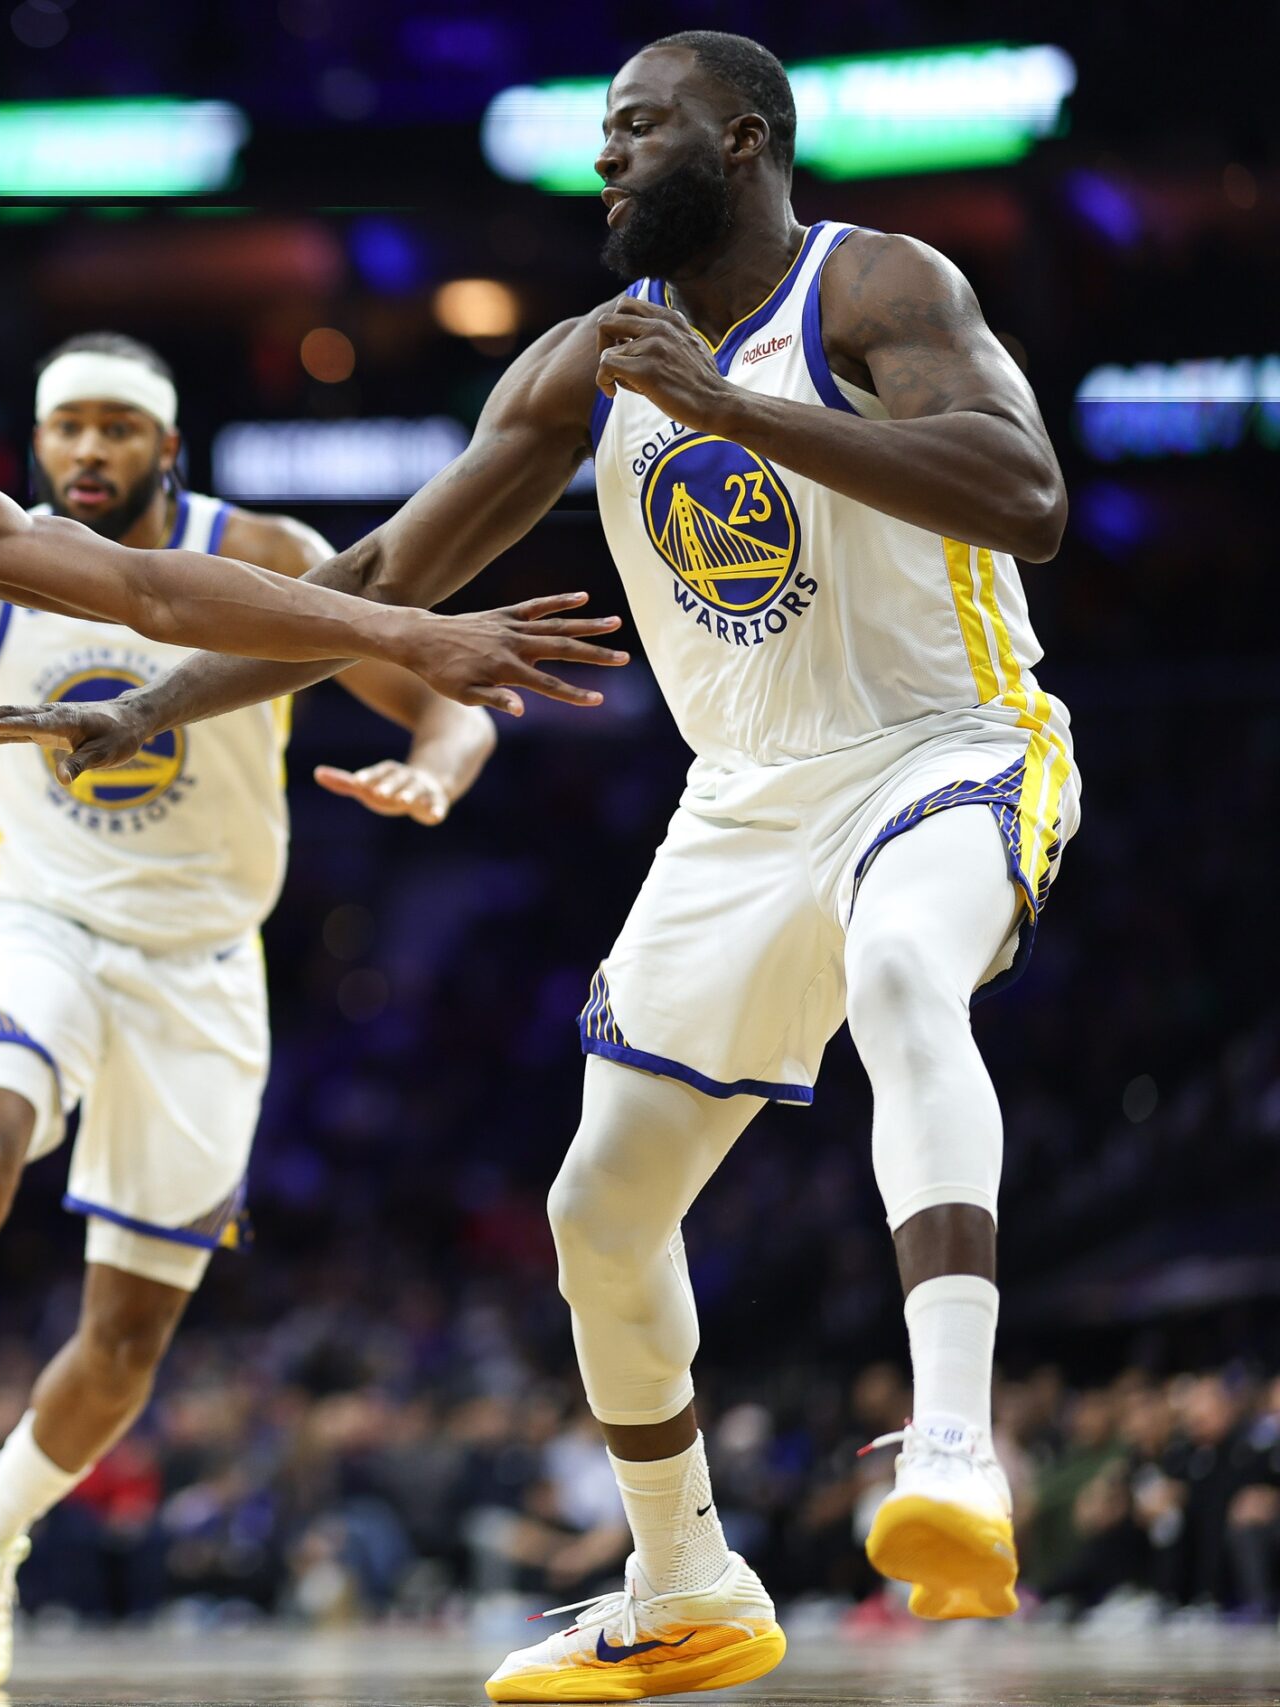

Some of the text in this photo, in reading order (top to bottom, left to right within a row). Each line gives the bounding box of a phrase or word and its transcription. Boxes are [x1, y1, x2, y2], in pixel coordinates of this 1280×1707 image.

[741, 333, 793, 365] Rakuten
[631, 420, 687, 477] GOLD
[724, 471, 773, 525] 23
[672, 571, 819, 648] WARRIORS
